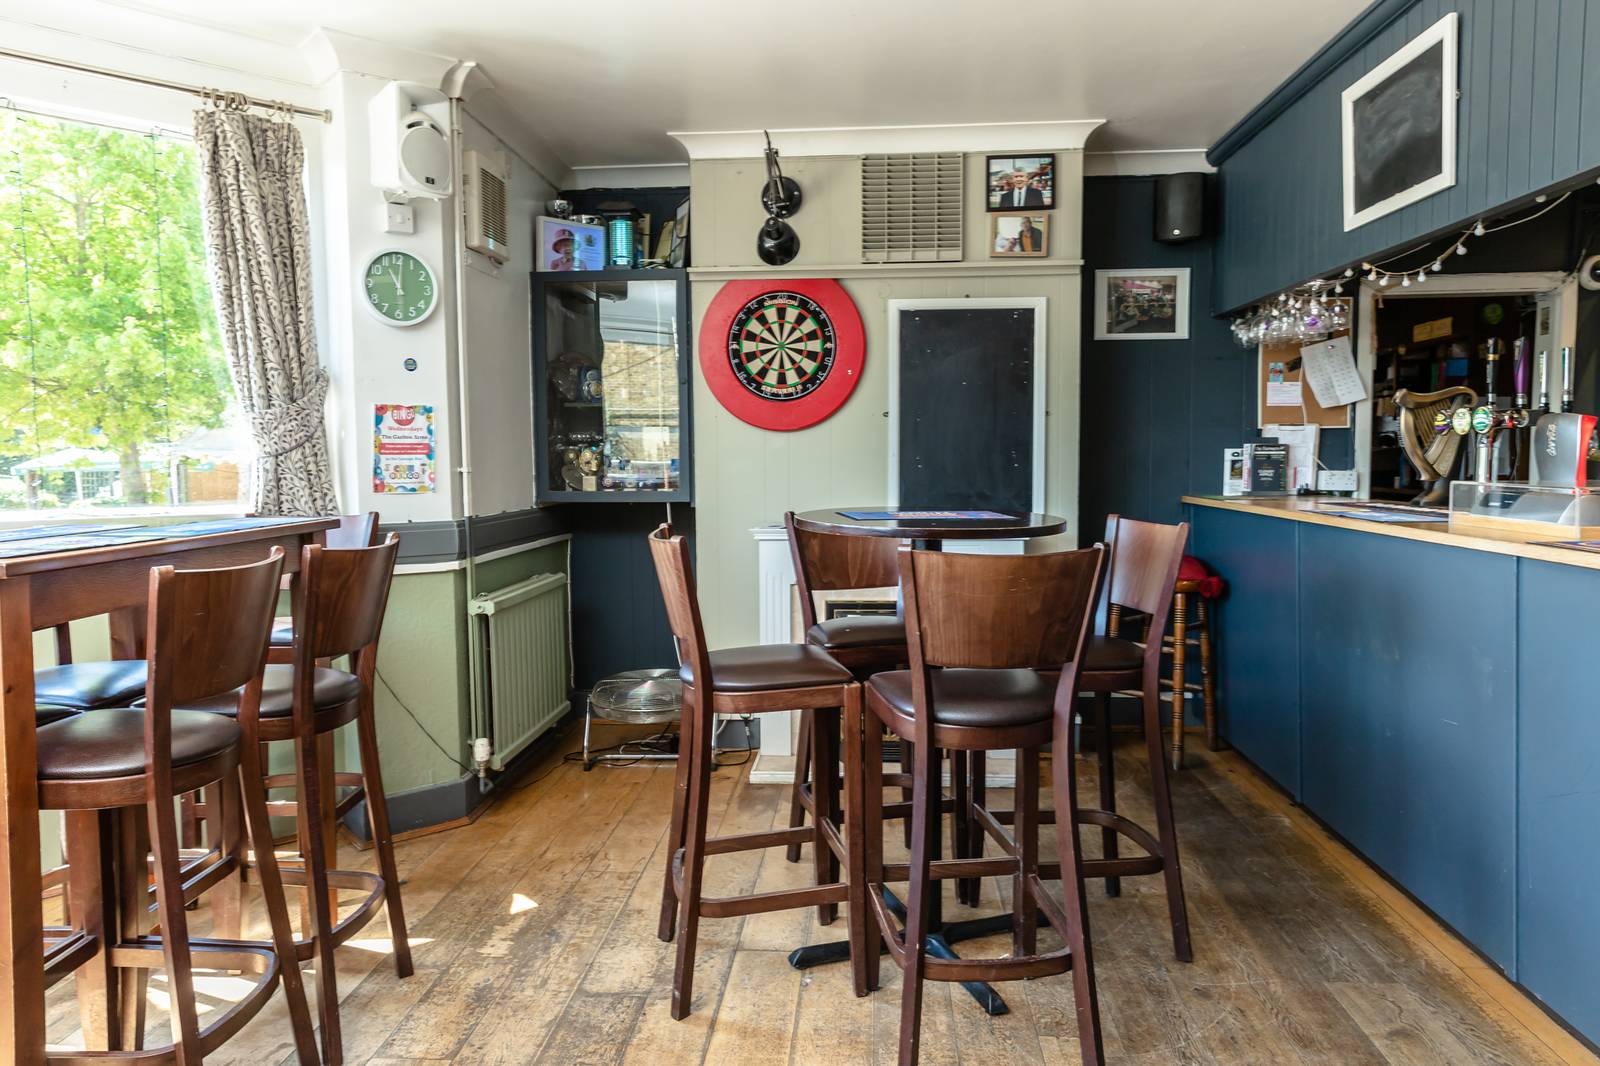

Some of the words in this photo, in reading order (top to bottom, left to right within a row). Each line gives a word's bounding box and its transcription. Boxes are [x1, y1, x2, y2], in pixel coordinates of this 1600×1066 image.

[382, 255, 389, 267] 11
[392, 254, 403, 265] 12
[410, 259, 414, 270] 1
[371, 264, 382, 275] 10
[418, 270, 426, 281] 2
[423, 285, 431, 296] 3
[371, 293, 378, 304] 8
[382, 303, 389, 313] 7
[417, 299, 425, 310] 4
[394, 309, 403, 319] 6
[408, 306, 416, 317] 5
